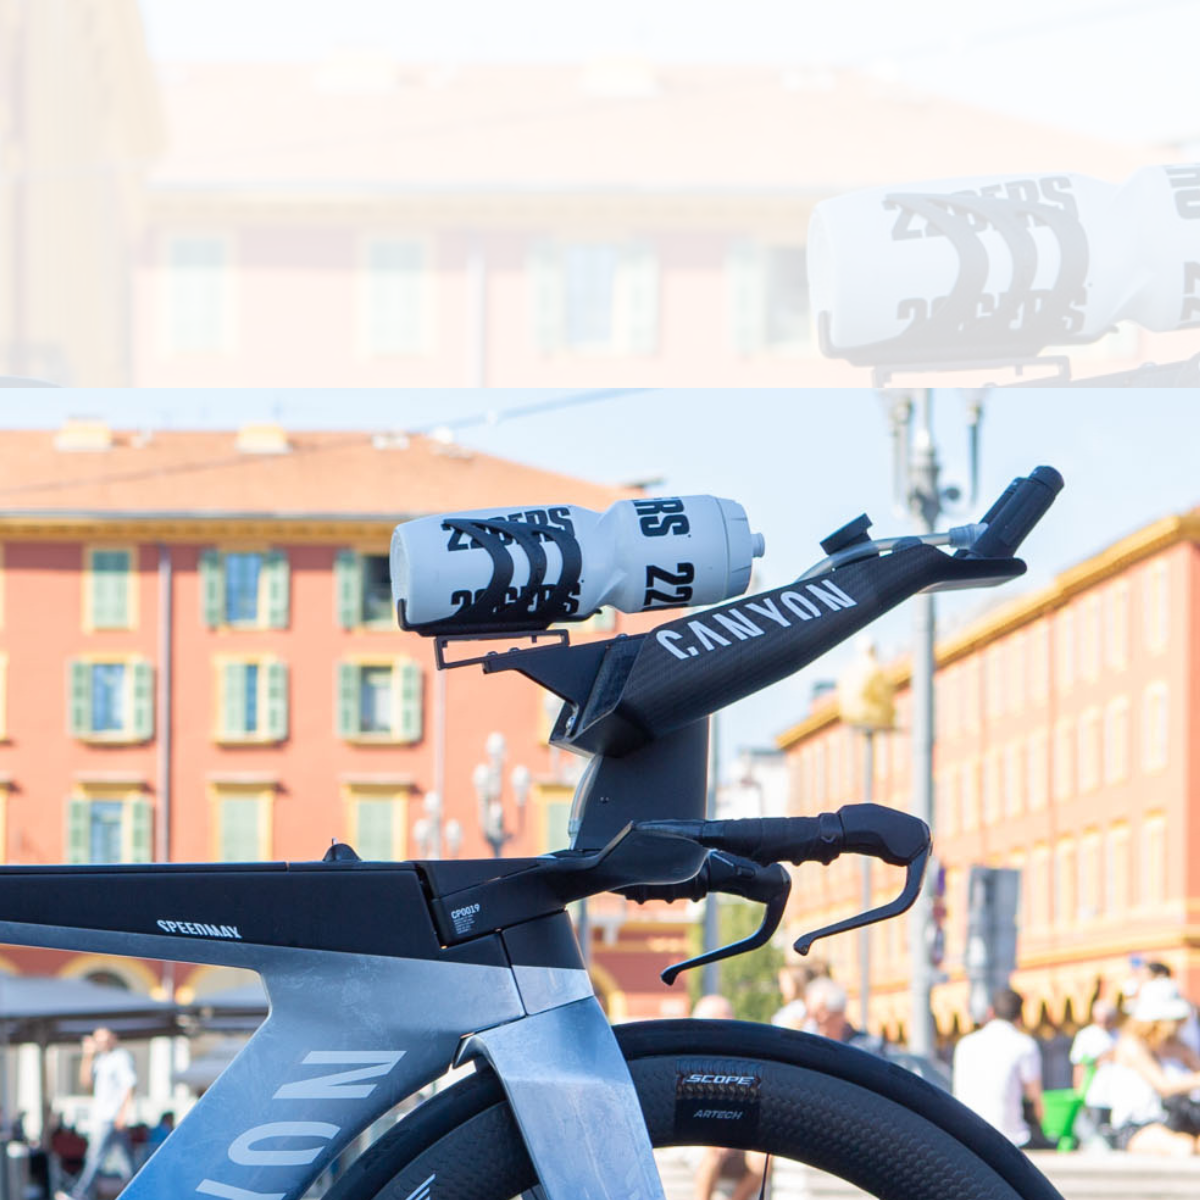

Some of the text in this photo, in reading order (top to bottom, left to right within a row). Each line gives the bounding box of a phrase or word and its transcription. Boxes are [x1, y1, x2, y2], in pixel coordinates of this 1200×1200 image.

[656, 578, 858, 660] CANYON
[156, 919, 242, 939] SPEEDMAX
[686, 1073, 755, 1086] SCOPE
[693, 1109, 743, 1120] ARTECH
